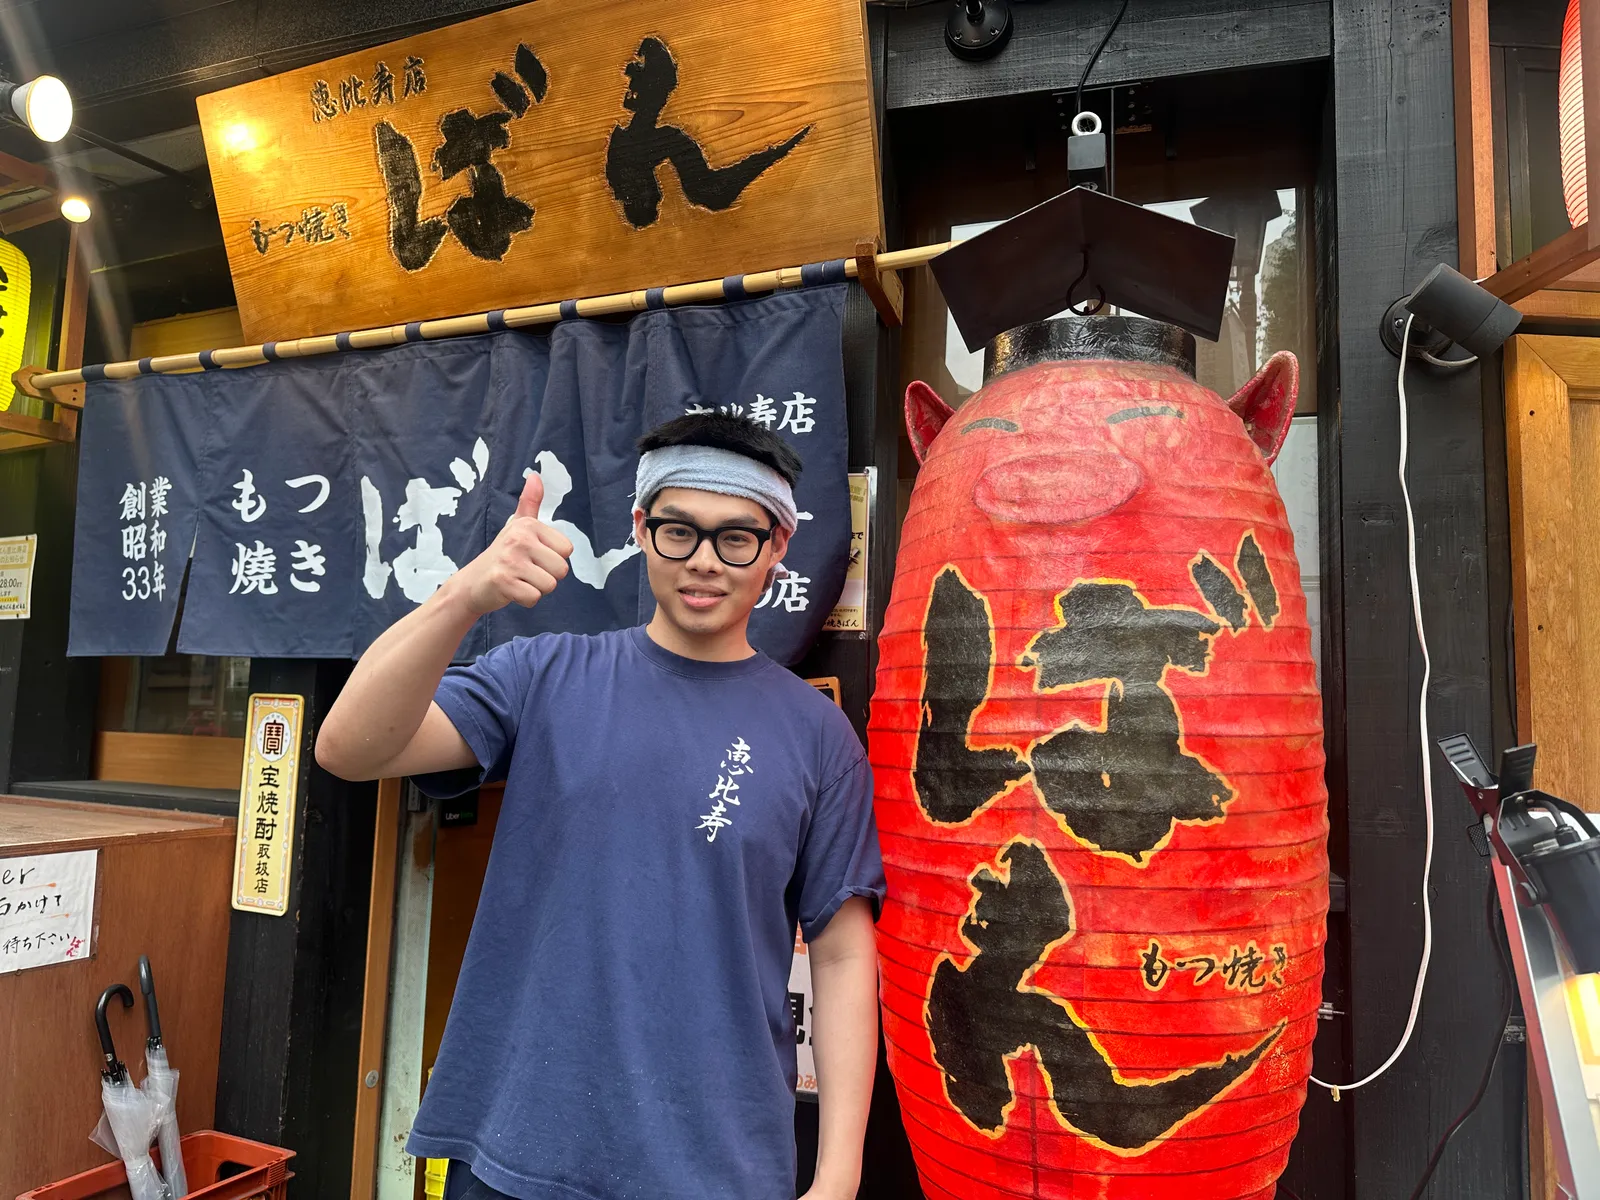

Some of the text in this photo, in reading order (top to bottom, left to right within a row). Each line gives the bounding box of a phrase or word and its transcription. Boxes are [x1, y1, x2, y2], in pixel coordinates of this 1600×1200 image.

[374, 36, 813, 273] ばん
[685, 391, 817, 435] 寿店
[232, 468, 331, 523] もつ
[360, 436, 642, 604] ばん
[695, 736, 754, 843] 恵比寿
[912, 529, 1288, 1157] ばん
[1142, 942, 1285, 988] もつ焼き
